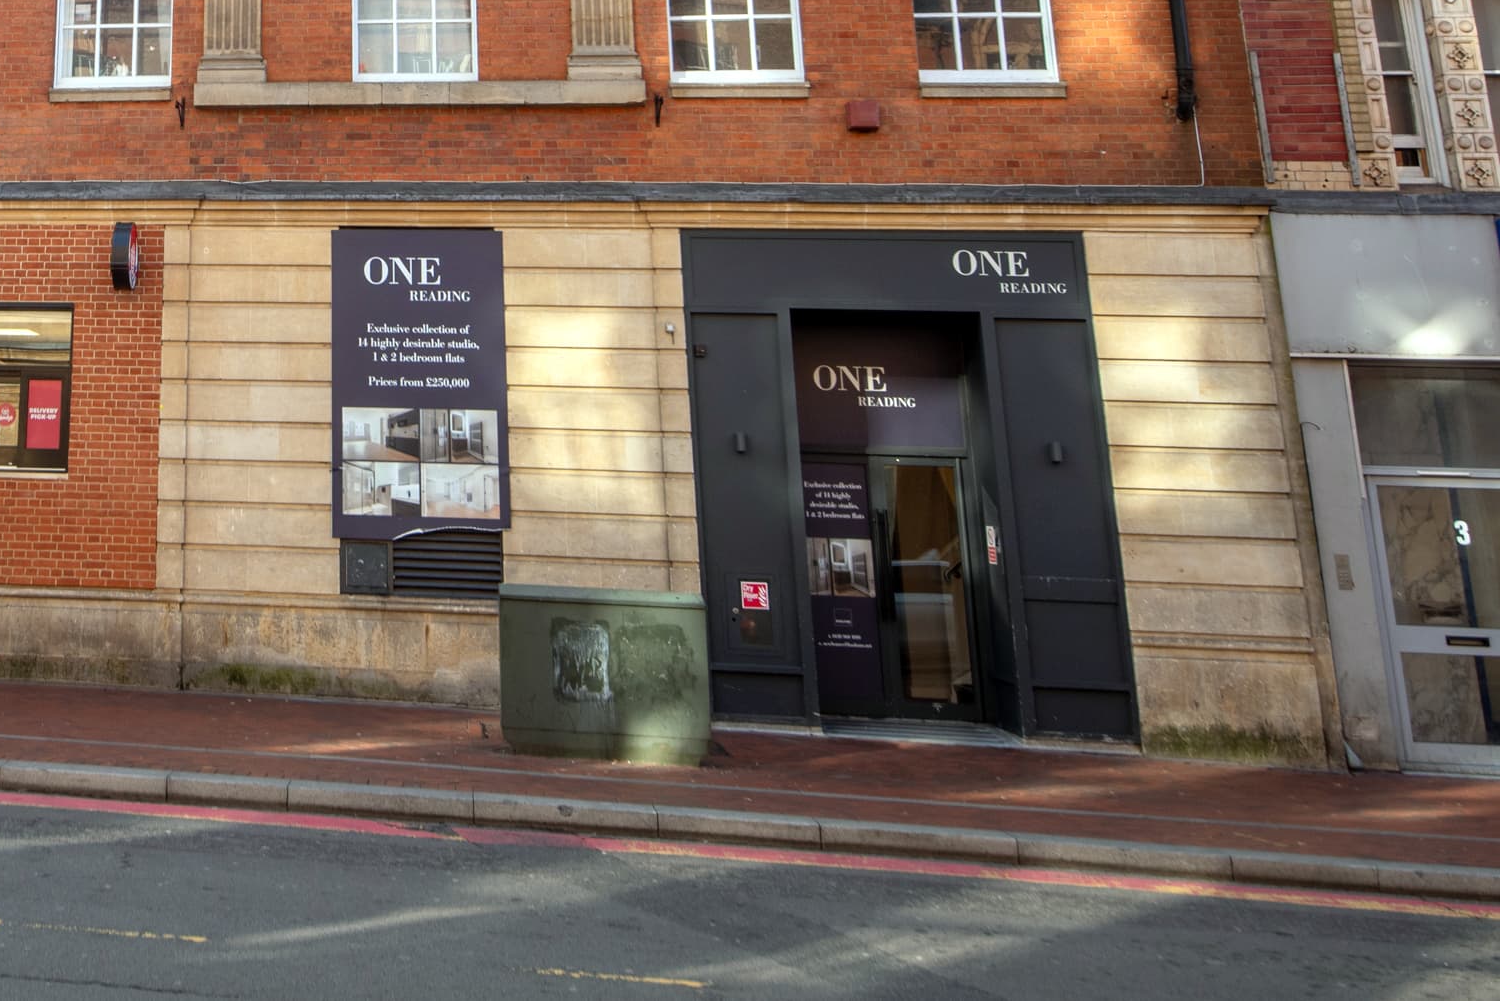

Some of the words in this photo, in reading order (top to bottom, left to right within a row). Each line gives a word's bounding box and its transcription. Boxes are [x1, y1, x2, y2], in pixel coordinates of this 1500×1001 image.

[952, 249, 1030, 277] ONE
[363, 256, 442, 286] ONE
[999, 282, 1068, 294] READING
[409, 290, 471, 302] READING
[367, 323, 411, 334] Exclusive
[412, 324, 457, 335] collection
[459, 325, 471, 335] of
[358, 338, 368, 348] 14
[370, 338, 401, 351] highly
[402, 338, 446, 349] desirable
[447, 339, 480, 351] studio,
[373, 352, 378, 362] 1
[380, 353, 388, 362] &
[390, 352, 397, 362] 2
[399, 352, 443, 363] bedroom
[445, 353, 465, 363] flats
[368, 376, 398, 386] Prices
[400, 376, 424, 387] from
[425, 377, 470, 389] £250,000
[813, 364, 887, 392] ONE
[858, 396, 917, 408] READING
[1453, 519, 1471, 545] 3
